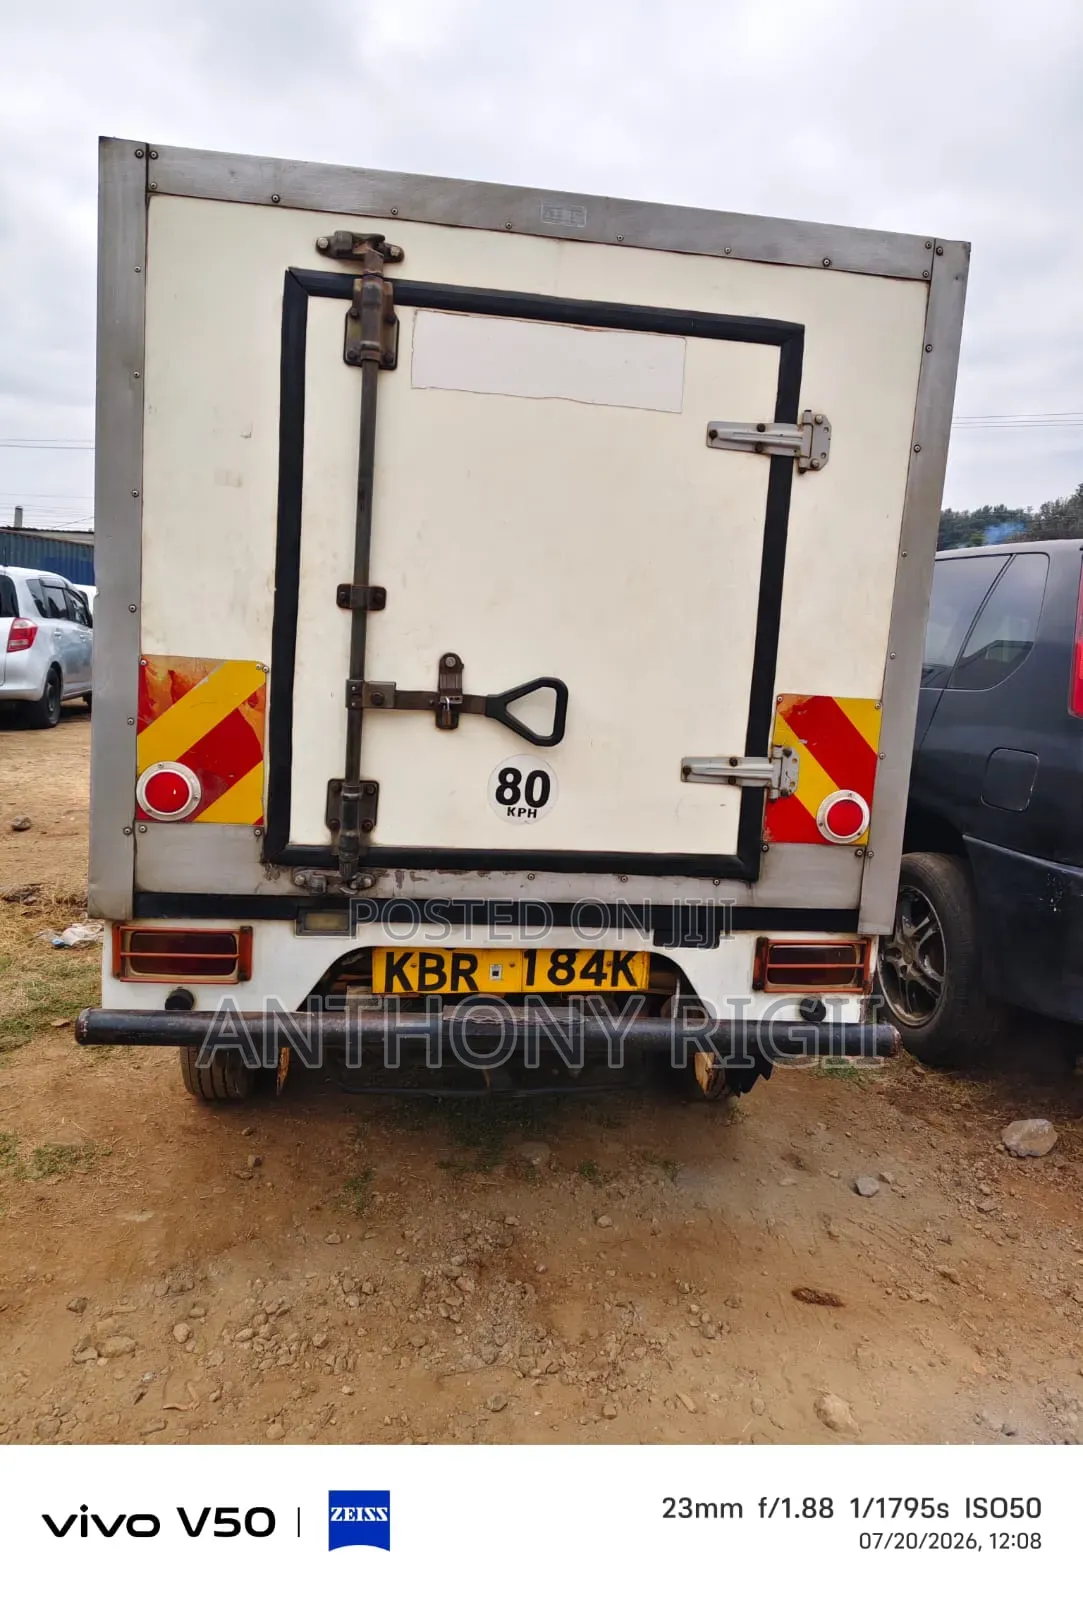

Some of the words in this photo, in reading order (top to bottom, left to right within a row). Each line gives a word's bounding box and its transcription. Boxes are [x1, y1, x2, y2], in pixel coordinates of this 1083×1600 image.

[495, 767, 551, 808] 80
[507, 806, 538, 819] KPH
[384, 951, 480, 992] KBR
[522, 949, 638, 987] 184K
